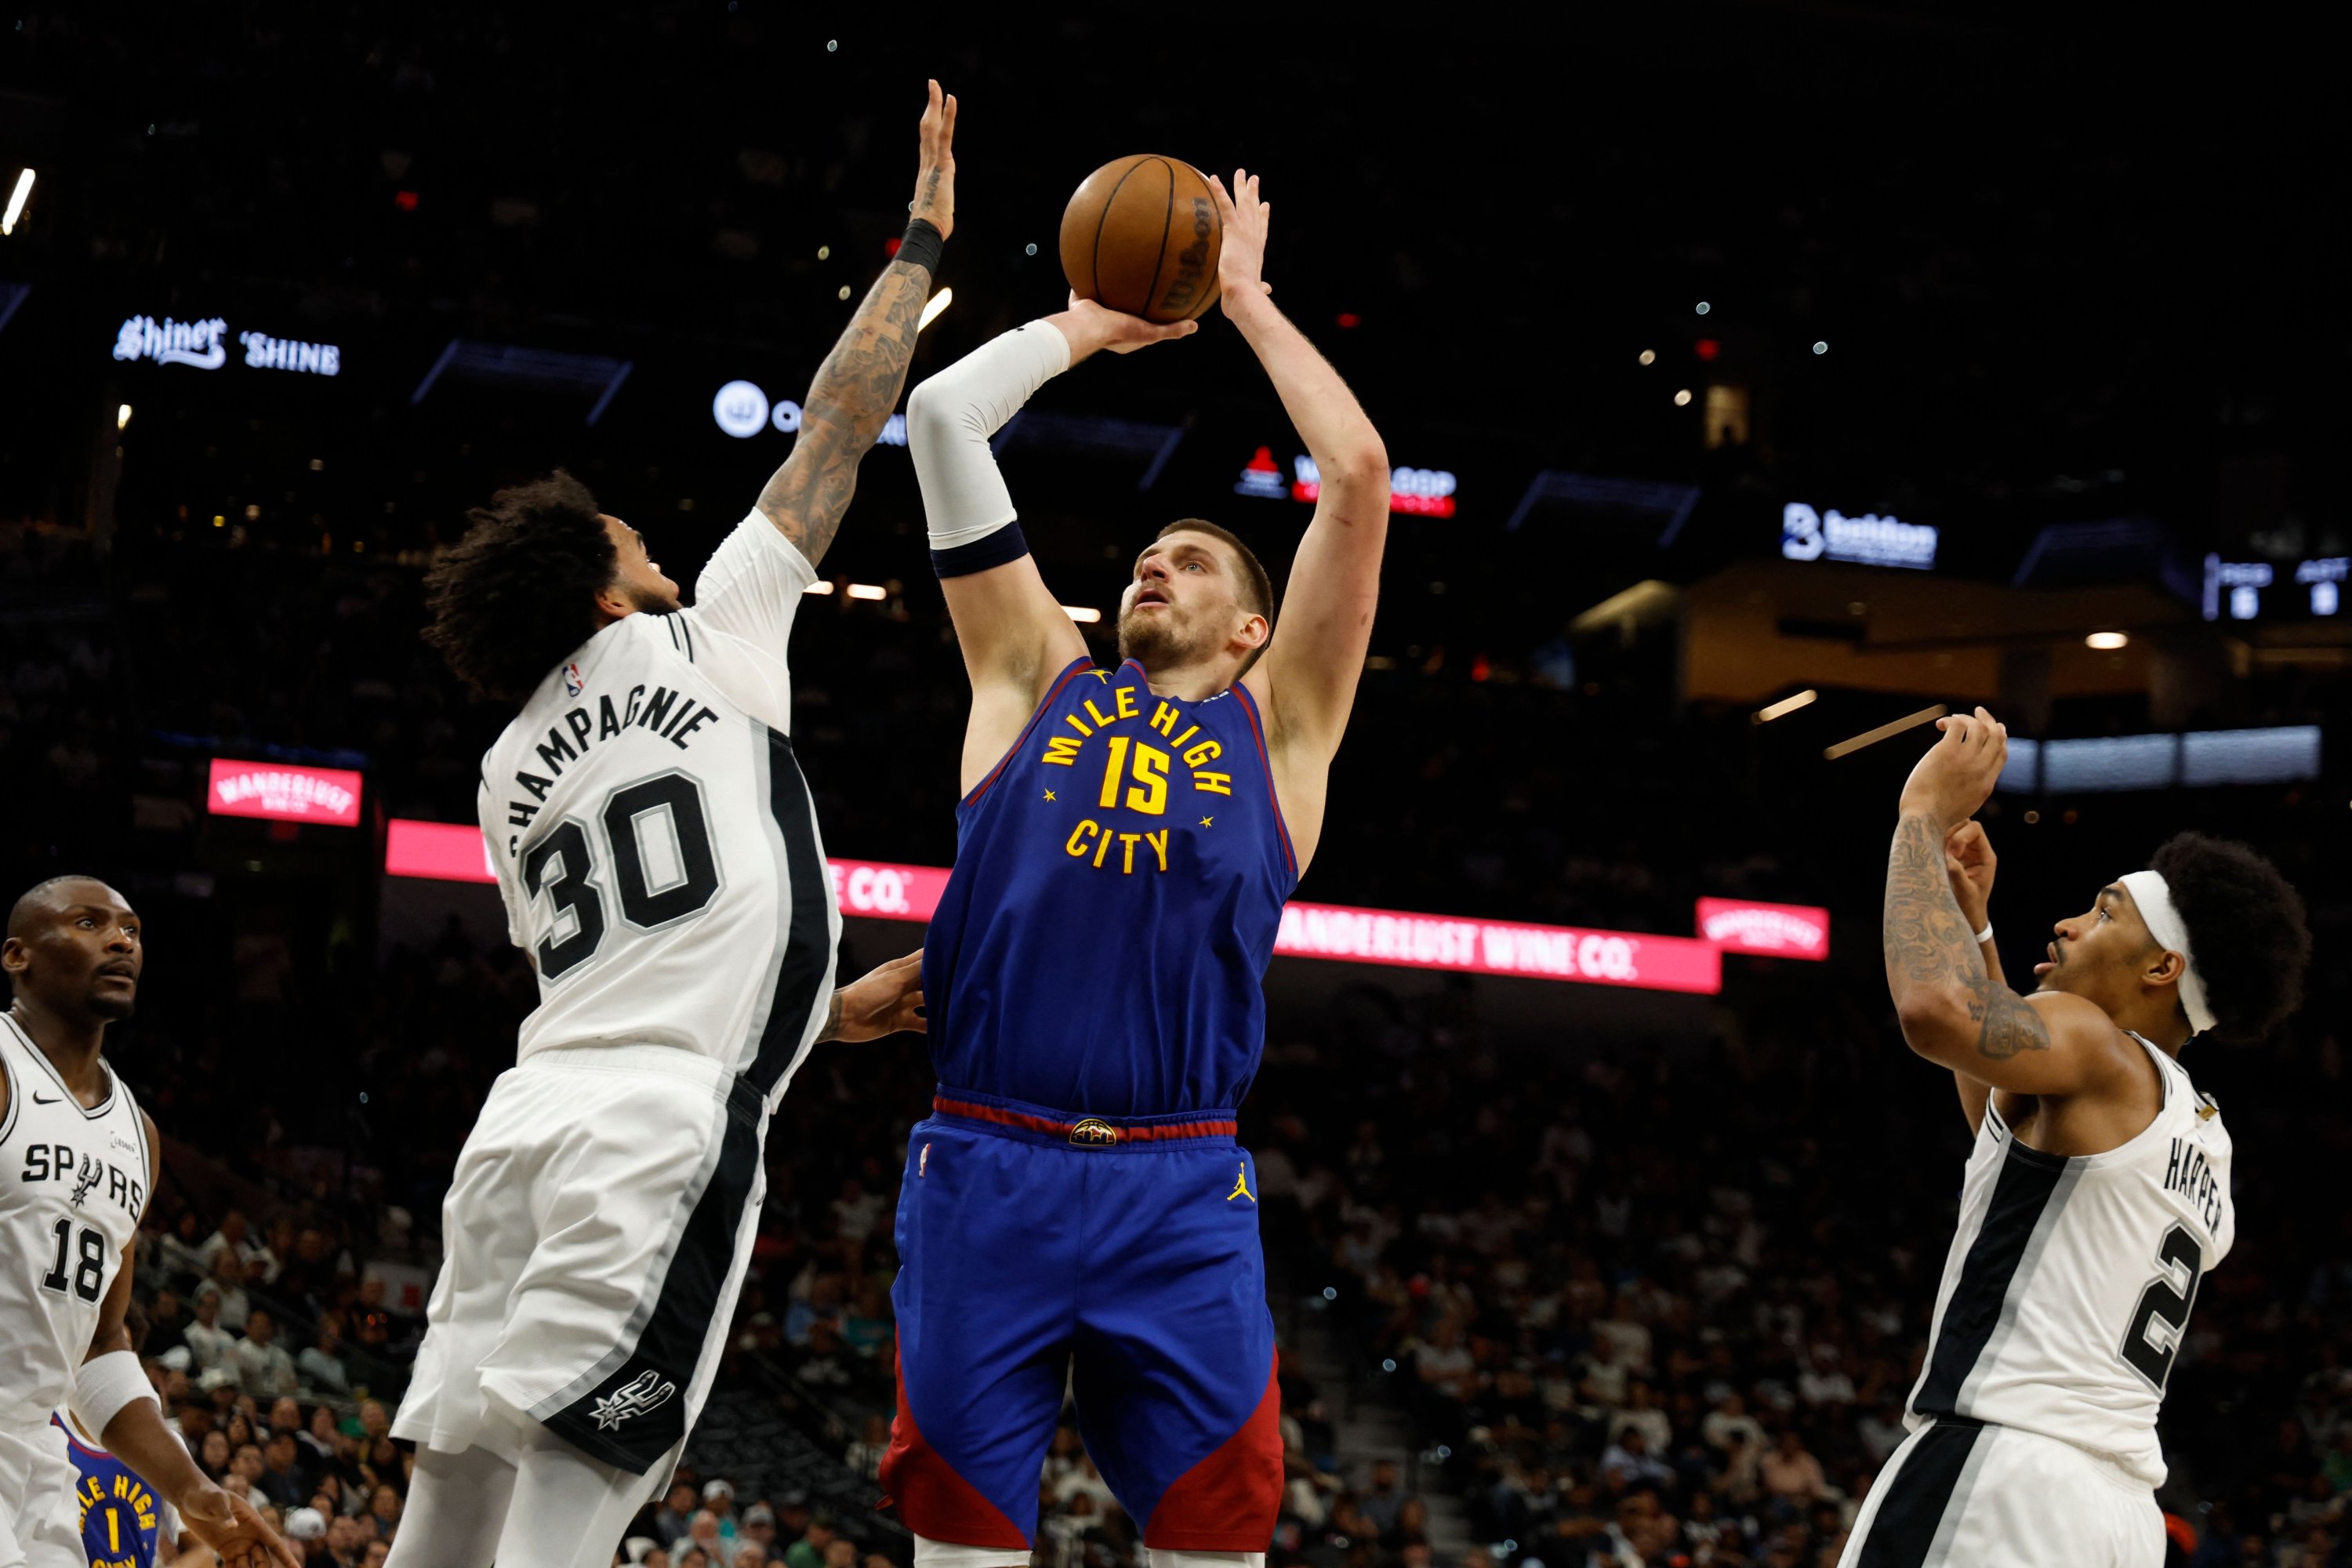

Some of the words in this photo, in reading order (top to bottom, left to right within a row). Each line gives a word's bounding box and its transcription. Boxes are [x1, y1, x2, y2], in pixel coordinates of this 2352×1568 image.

[112, 314, 227, 370] Shiner
[1041, 686, 1139, 767] MILE
[1149, 700, 1232, 797] HIGH
[1098, 735, 1171, 816] 15
[519, 766, 728, 988] 30
[1065, 818, 1170, 875] CITY
[1273, 906, 1480, 966] ANDERLUST
[1481, 925, 1578, 975] WINE
[2164, 1137, 2222, 1243] HARPER
[42, 1214, 104, 1308] 18
[2118, 1218, 2204, 1404] 2
[105, 1507, 120, 1554] 1
[113, 1474, 156, 1530] HIGH
